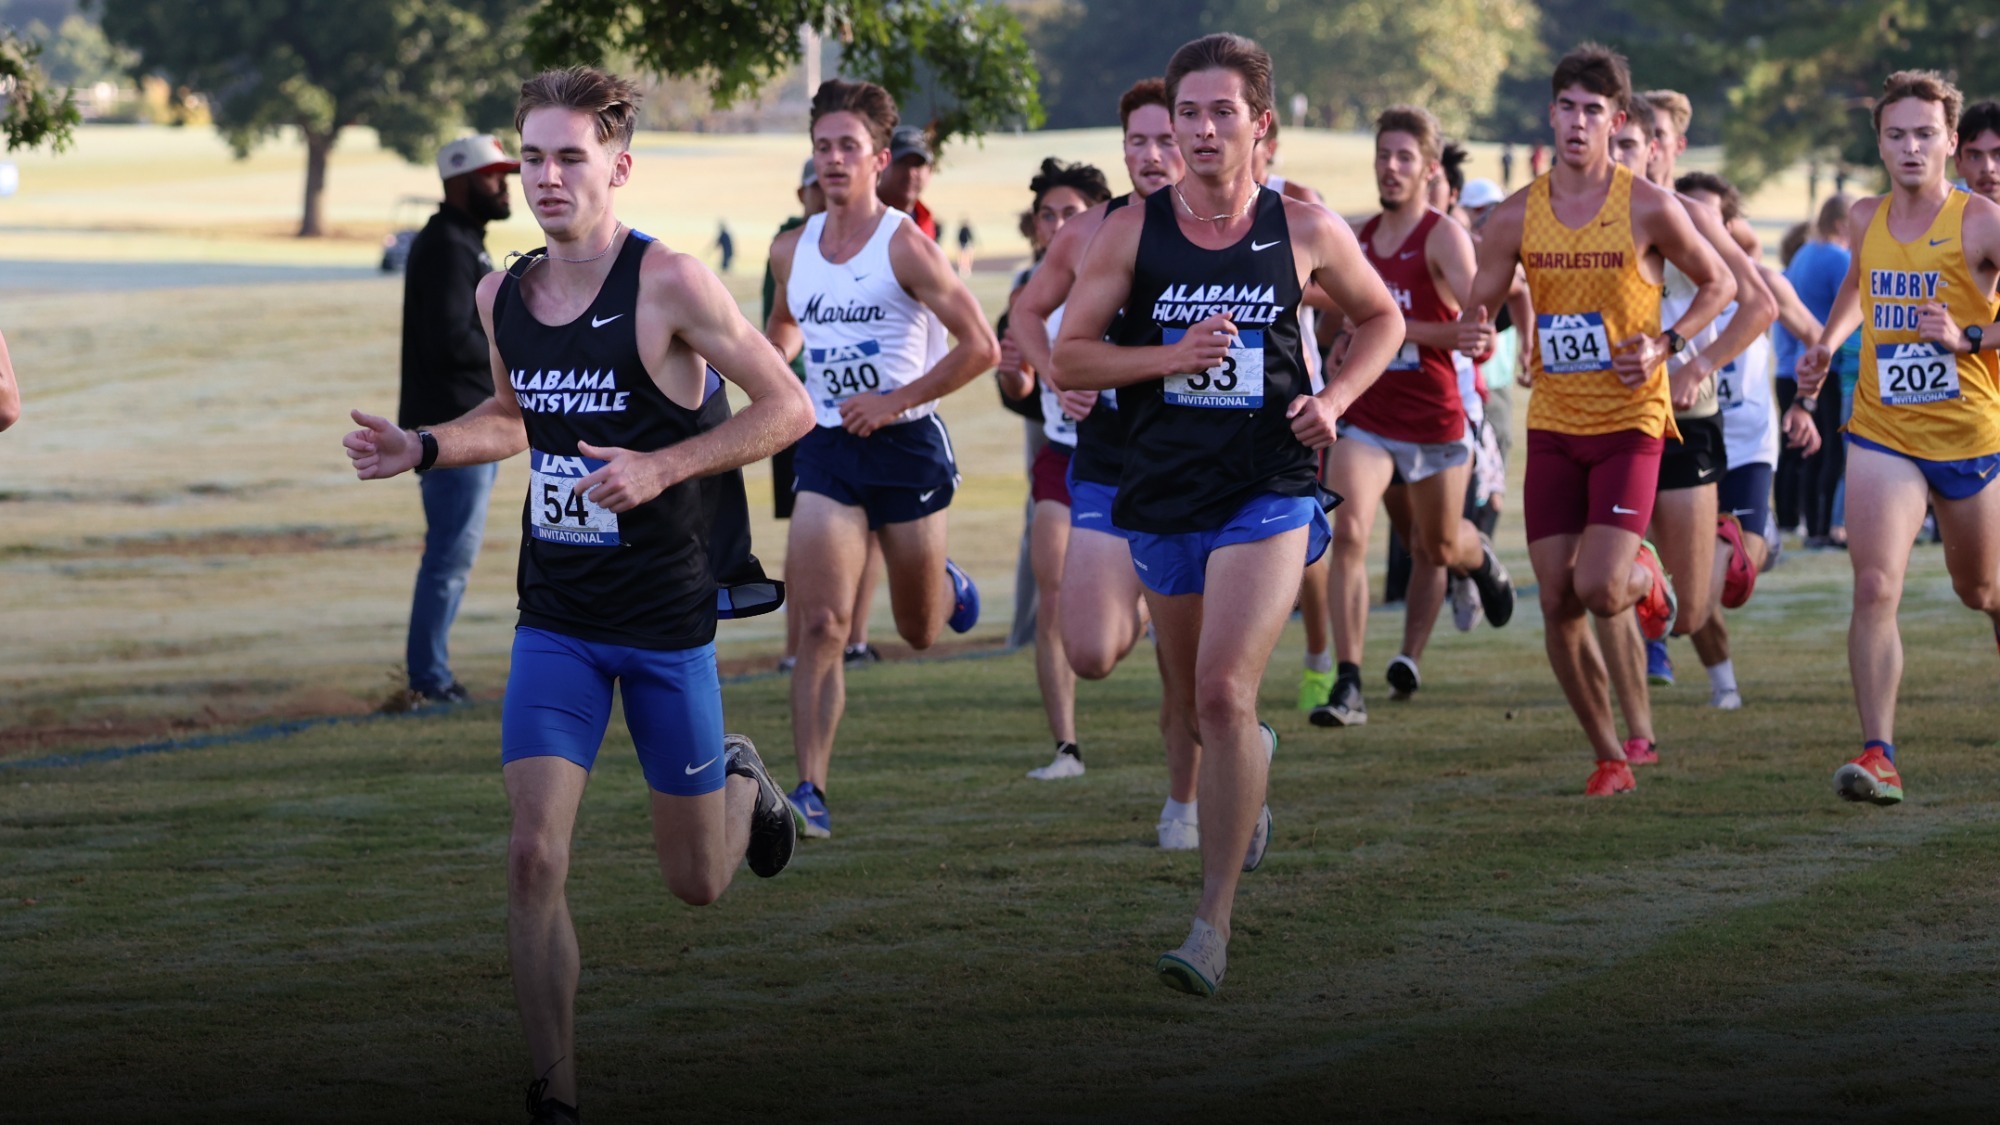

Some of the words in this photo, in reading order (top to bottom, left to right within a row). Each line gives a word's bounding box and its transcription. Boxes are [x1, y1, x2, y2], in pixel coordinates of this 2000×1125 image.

[1527, 251, 1624, 269] CHARLESTON
[1158, 283, 1275, 303] ALABAMA
[1870, 269, 1949, 298] EMBRY-
[799, 293, 886, 325] Marian
[1152, 303, 1285, 324] HUNTSVILLE
[1873, 303, 1948, 331] RIDD
[1548, 332, 1600, 361] 134
[509, 368, 616, 390] ALABAMA
[823, 363, 880, 395] 340
[1187, 356, 1238, 391] 33
[1887, 361, 1949, 392] 202
[515, 391, 631, 415] UNTSVILLE
[1177, 394, 1250, 406] INVITATIONAL
[1891, 392, 1949, 405] INVITATIONAL
[543, 482, 589, 526] 54
[538, 527, 605, 544] INVITATIONAL
